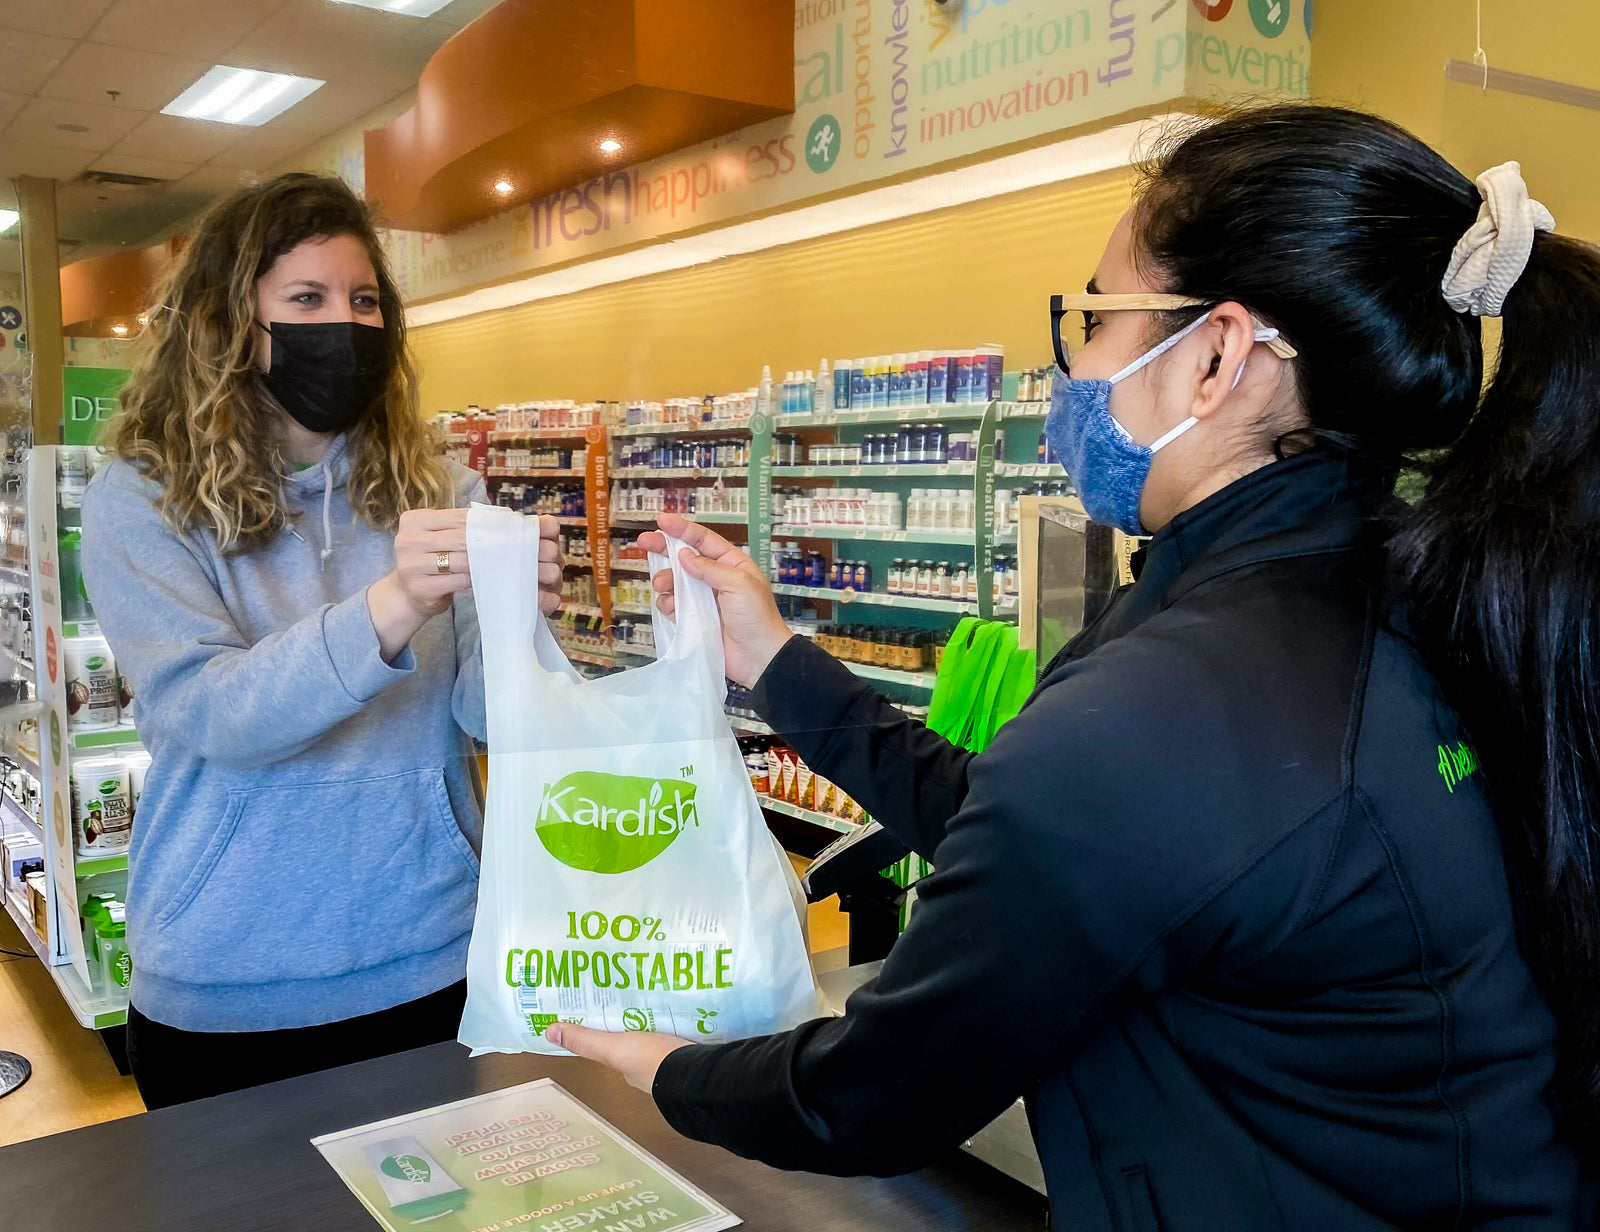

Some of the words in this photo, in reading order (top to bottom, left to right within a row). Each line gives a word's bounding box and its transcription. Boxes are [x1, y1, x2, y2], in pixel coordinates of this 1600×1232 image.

[920, 8, 1091, 95] nutrition
[883, 0, 909, 159] knowle
[919, 69, 1089, 144] innovation
[633, 133, 797, 219] happiness
[595, 455, 606, 486] Bone
[595, 490, 608, 500] &
[758, 455, 770, 519] Vitamins
[984, 472, 995, 527] Health
[596, 504, 608, 534] Joint
[758, 522, 770, 534] &
[597, 537, 609, 585] Support
[984, 533, 993, 573] First
[541, 781, 700, 837] Kardish
[566, 911, 666, 941] 100%
[117, 952, 130, 990] Kardish
[505, 948, 733, 991] COMPOSTABLE
[507, 1110, 551, 1127] free
[511, 1120, 567, 1140] claim
[444, 1121, 504, 1146] prize!
[459, 1135, 508, 1156] your
[509, 1132, 570, 1155] today
[551, 1135, 601, 1157] your
[477, 1152, 549, 1180] review
[480, 1150, 508, 1162] to
[537, 1152, 600, 1177] Show
[503, 1171, 535, 1186] us
[601, 1178, 643, 1196] LEAVE
[540, 1191, 660, 1232] SHAKER
[563, 1198, 575, 1206] A
[577, 1192, 601, 1203] US
[503, 1203, 564, 1228] GOOGLE
